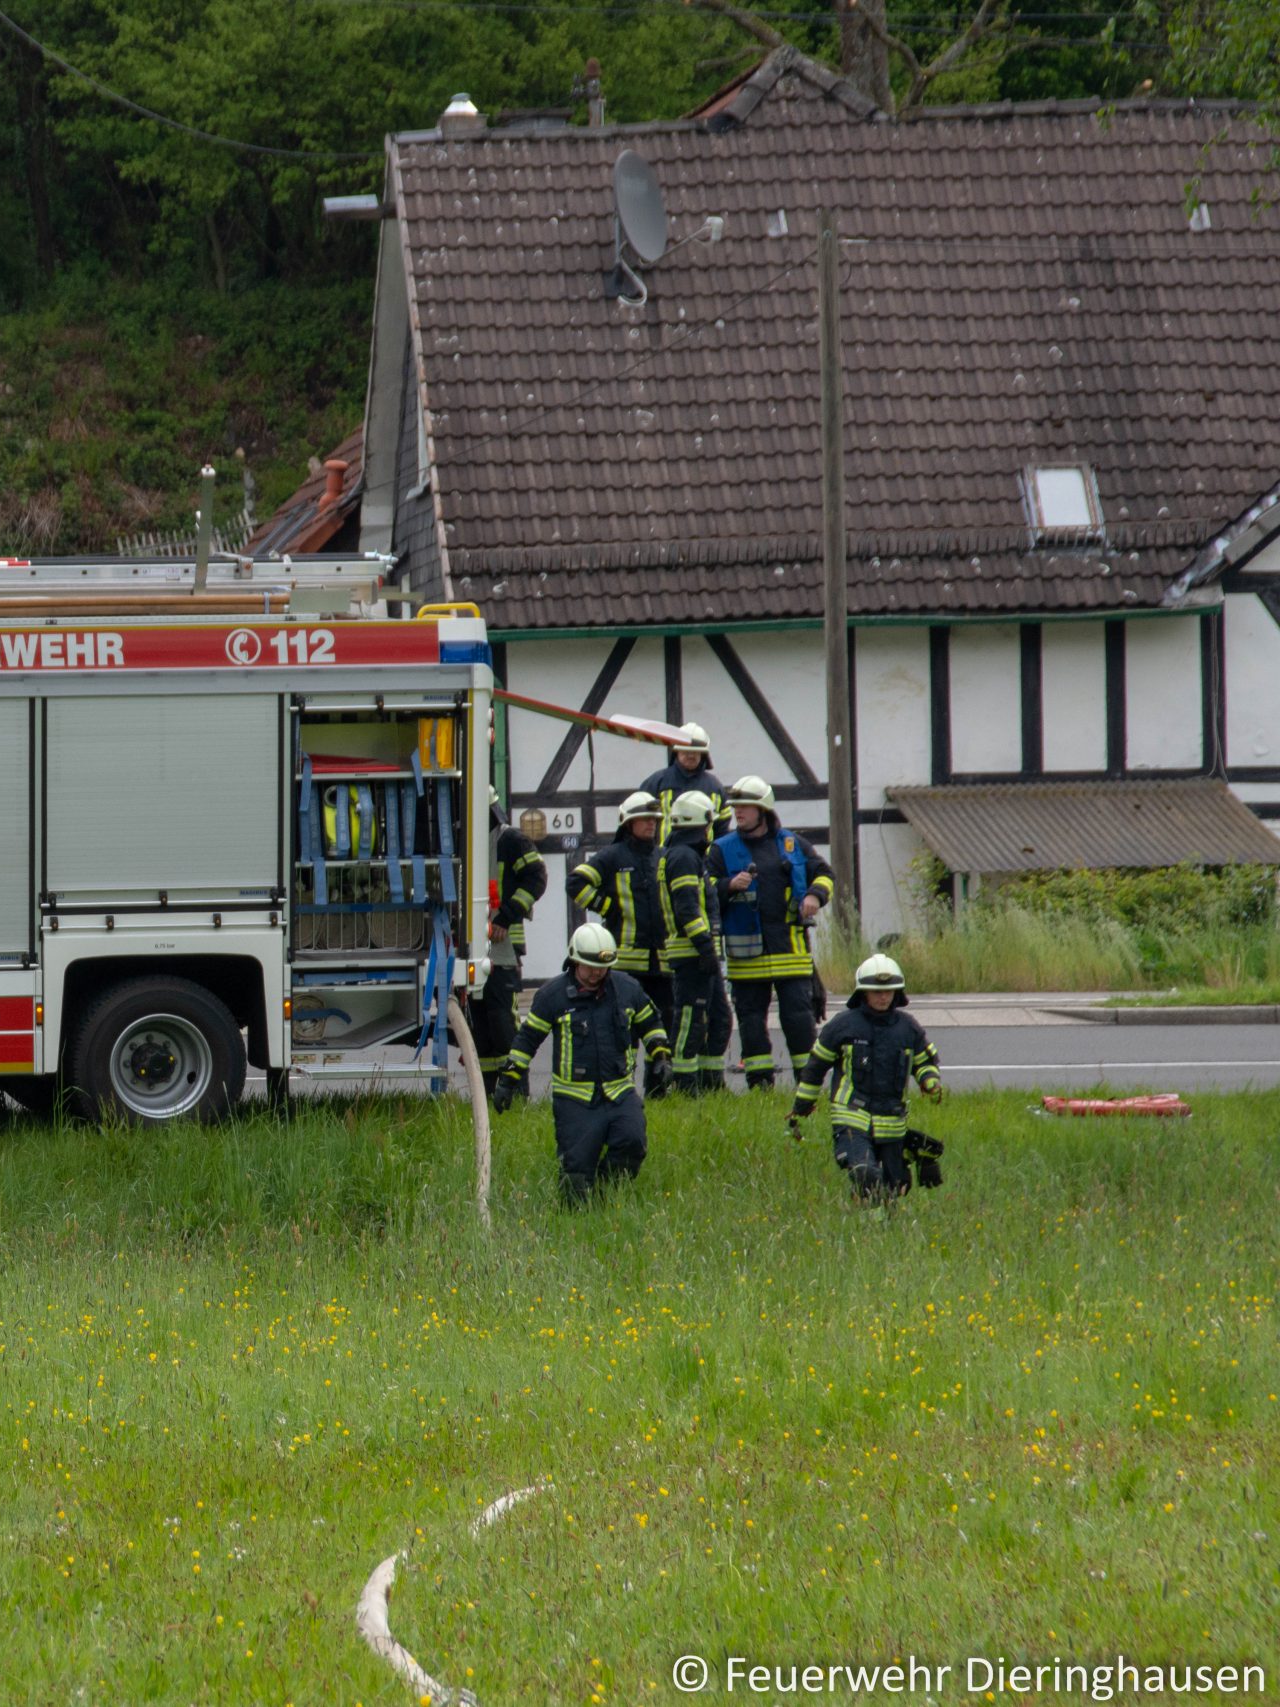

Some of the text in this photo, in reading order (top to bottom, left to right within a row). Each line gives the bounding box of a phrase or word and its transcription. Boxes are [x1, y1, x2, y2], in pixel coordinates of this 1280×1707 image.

[271, 630, 336, 664] 112
[552, 813, 575, 829] 60
[564, 838, 577, 847] 60
